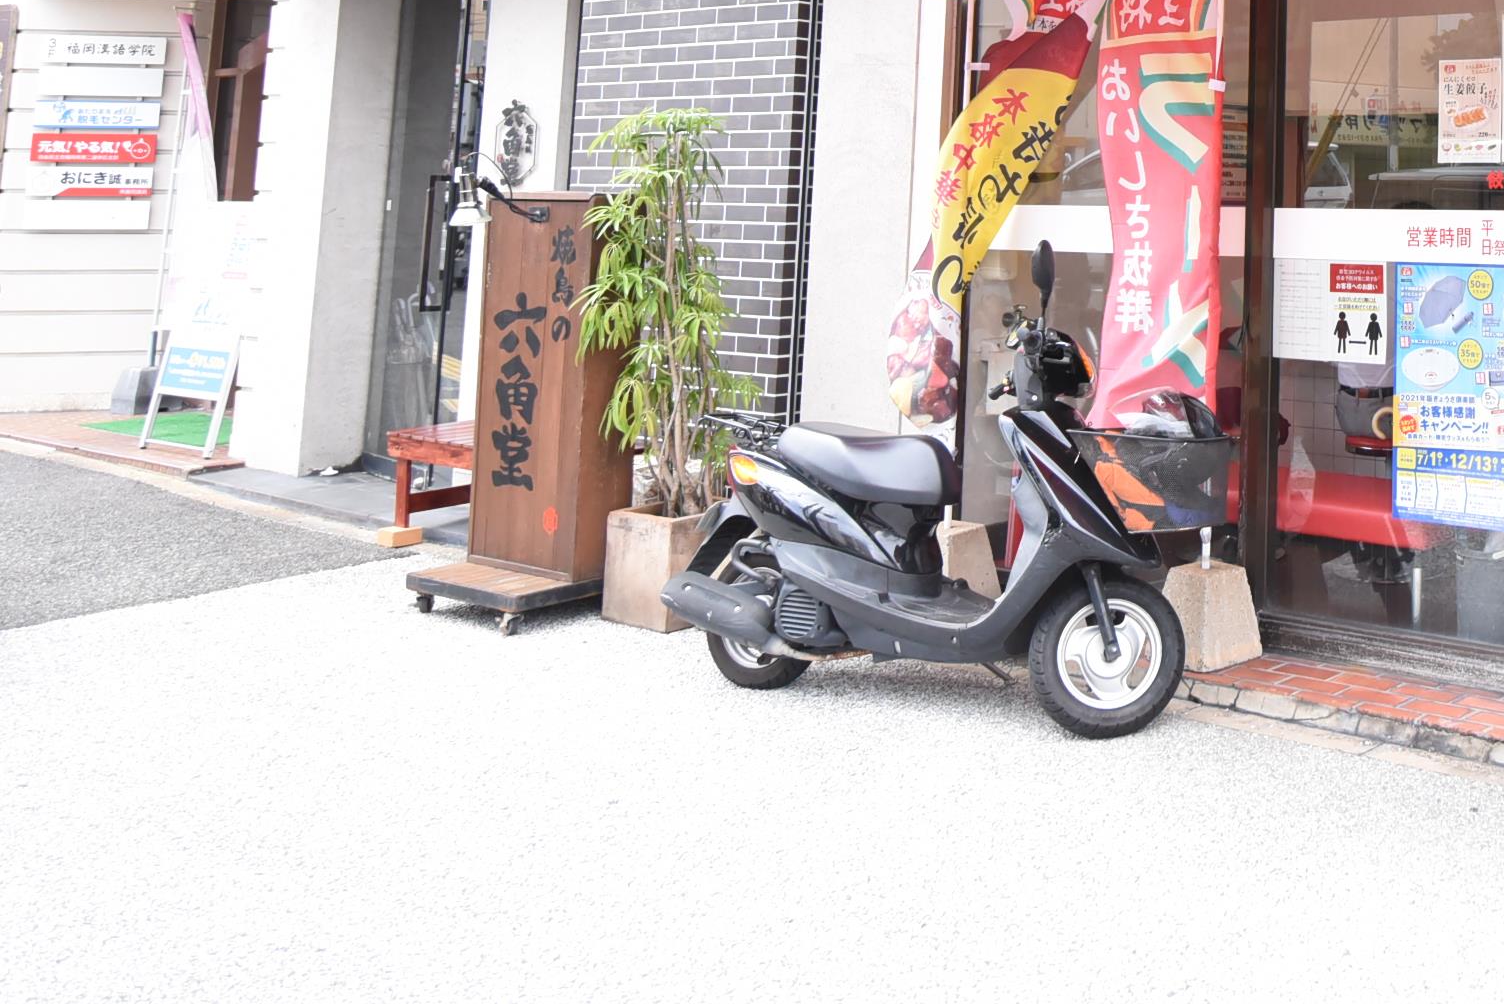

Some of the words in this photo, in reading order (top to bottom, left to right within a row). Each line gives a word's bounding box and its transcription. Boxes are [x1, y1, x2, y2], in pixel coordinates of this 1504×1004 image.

[60, 172, 122, 185] おにき誠
[1407, 226, 1472, 248] 営業時間
[550, 225, 577, 343] 焼鳥の
[1335, 283, 1378, 291] お客様へのお願い
[491, 291, 548, 491] 六角堂
[1420, 406, 1476, 419] お客様感謝
